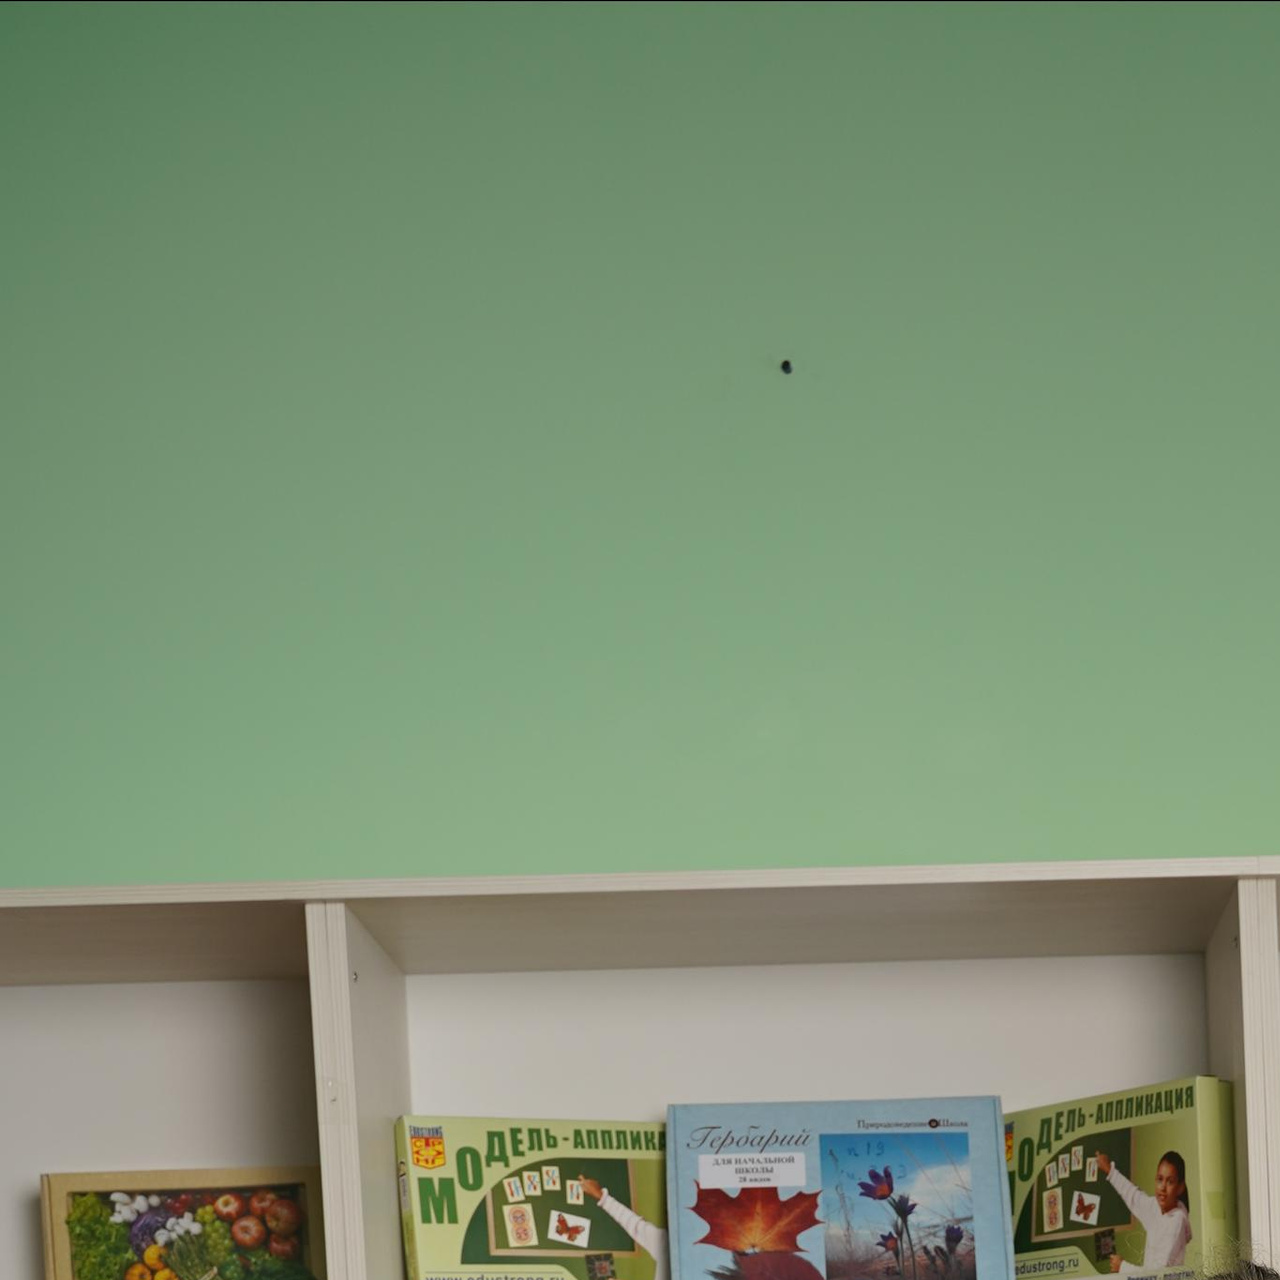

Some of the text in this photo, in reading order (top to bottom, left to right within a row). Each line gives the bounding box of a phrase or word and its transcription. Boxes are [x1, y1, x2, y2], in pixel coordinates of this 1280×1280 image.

[686, 1126, 811, 1155] Гербарий
[713, 1156, 795, 1166] ДЛЯ НАЧАЛЬНОЙ
[735, 1166, 774, 1175] ШКОЛЫ
